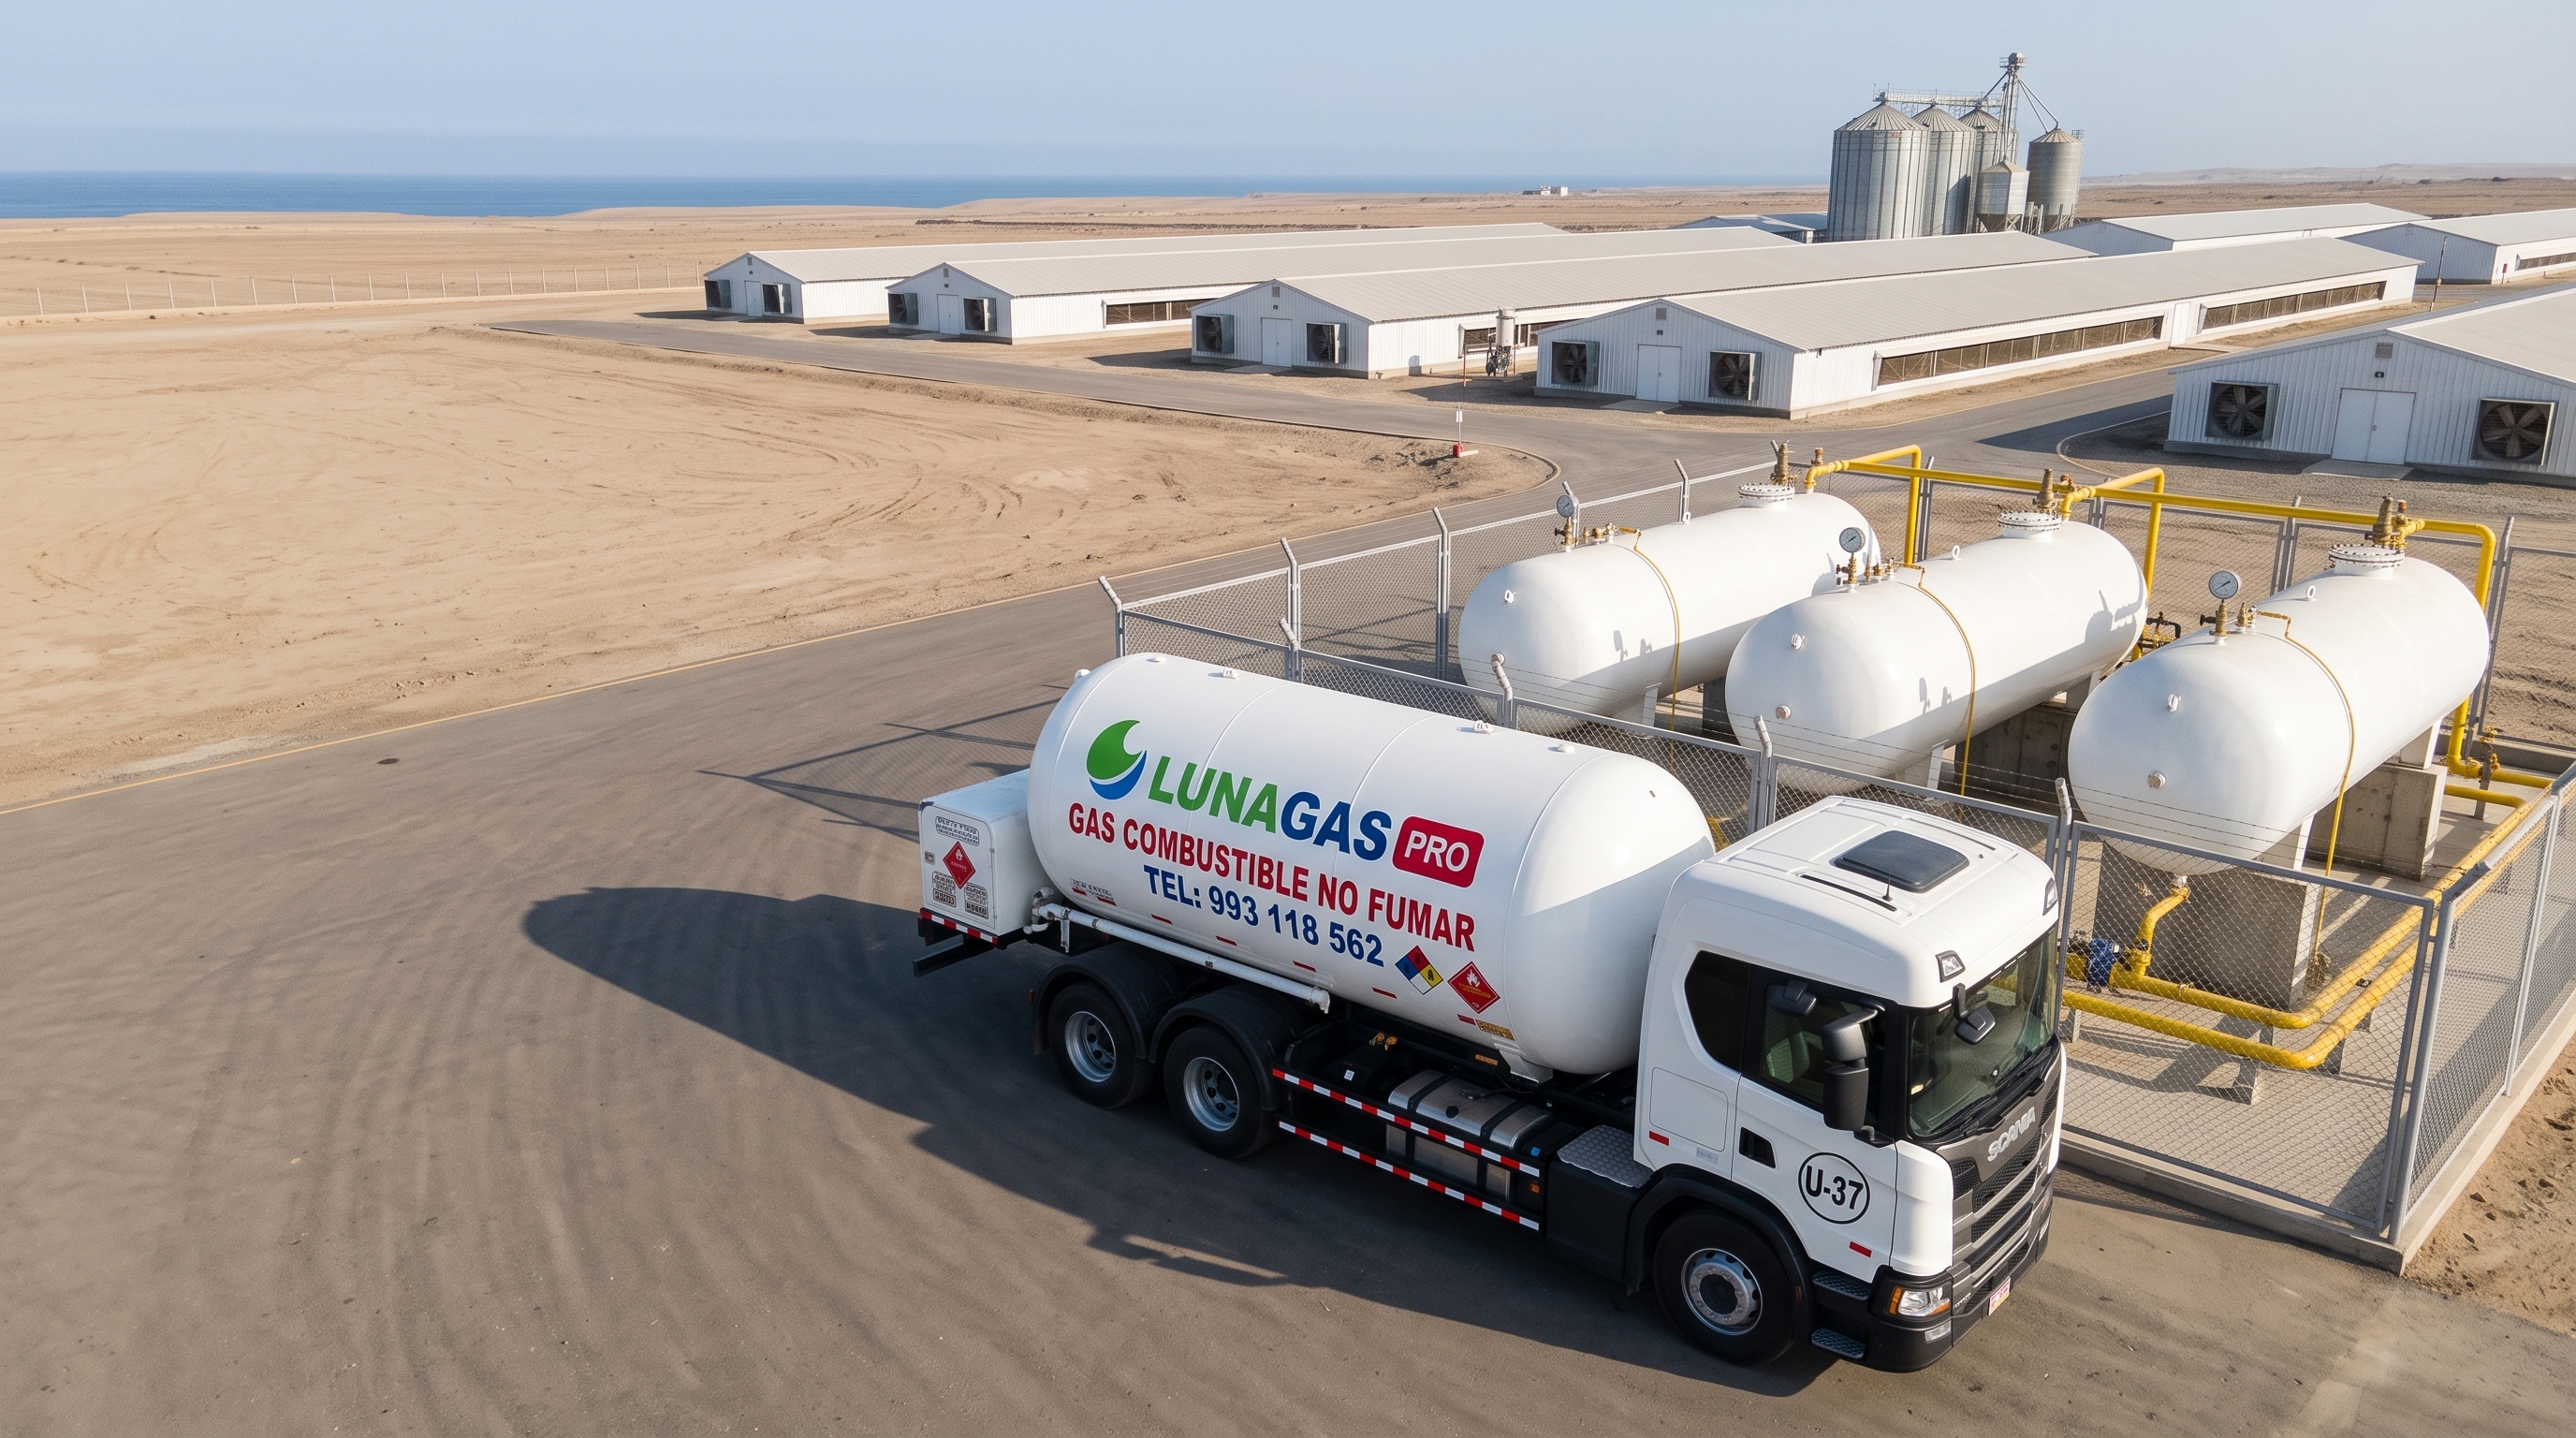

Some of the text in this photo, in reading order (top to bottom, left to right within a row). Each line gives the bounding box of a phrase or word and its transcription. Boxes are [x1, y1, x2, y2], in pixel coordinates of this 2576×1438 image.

[1149, 756, 1471, 873] LUNAGAS PRO
[1069, 802, 1115, 844] GAS
[1123, 818, 1310, 902] COMBUSTIBLE
[1318, 873, 1358, 916] NO
[1368, 888, 1476, 952] FUMAR
[1143, 864, 1202, 910] TEL:
[1208, 885, 1259, 927] 993
[1267, 903, 1319, 946] 118
[1329, 921, 1385, 968] 562
[1987, 1106, 2036, 1162] SCANIA
[1805, 1165, 1865, 1211] U-37
